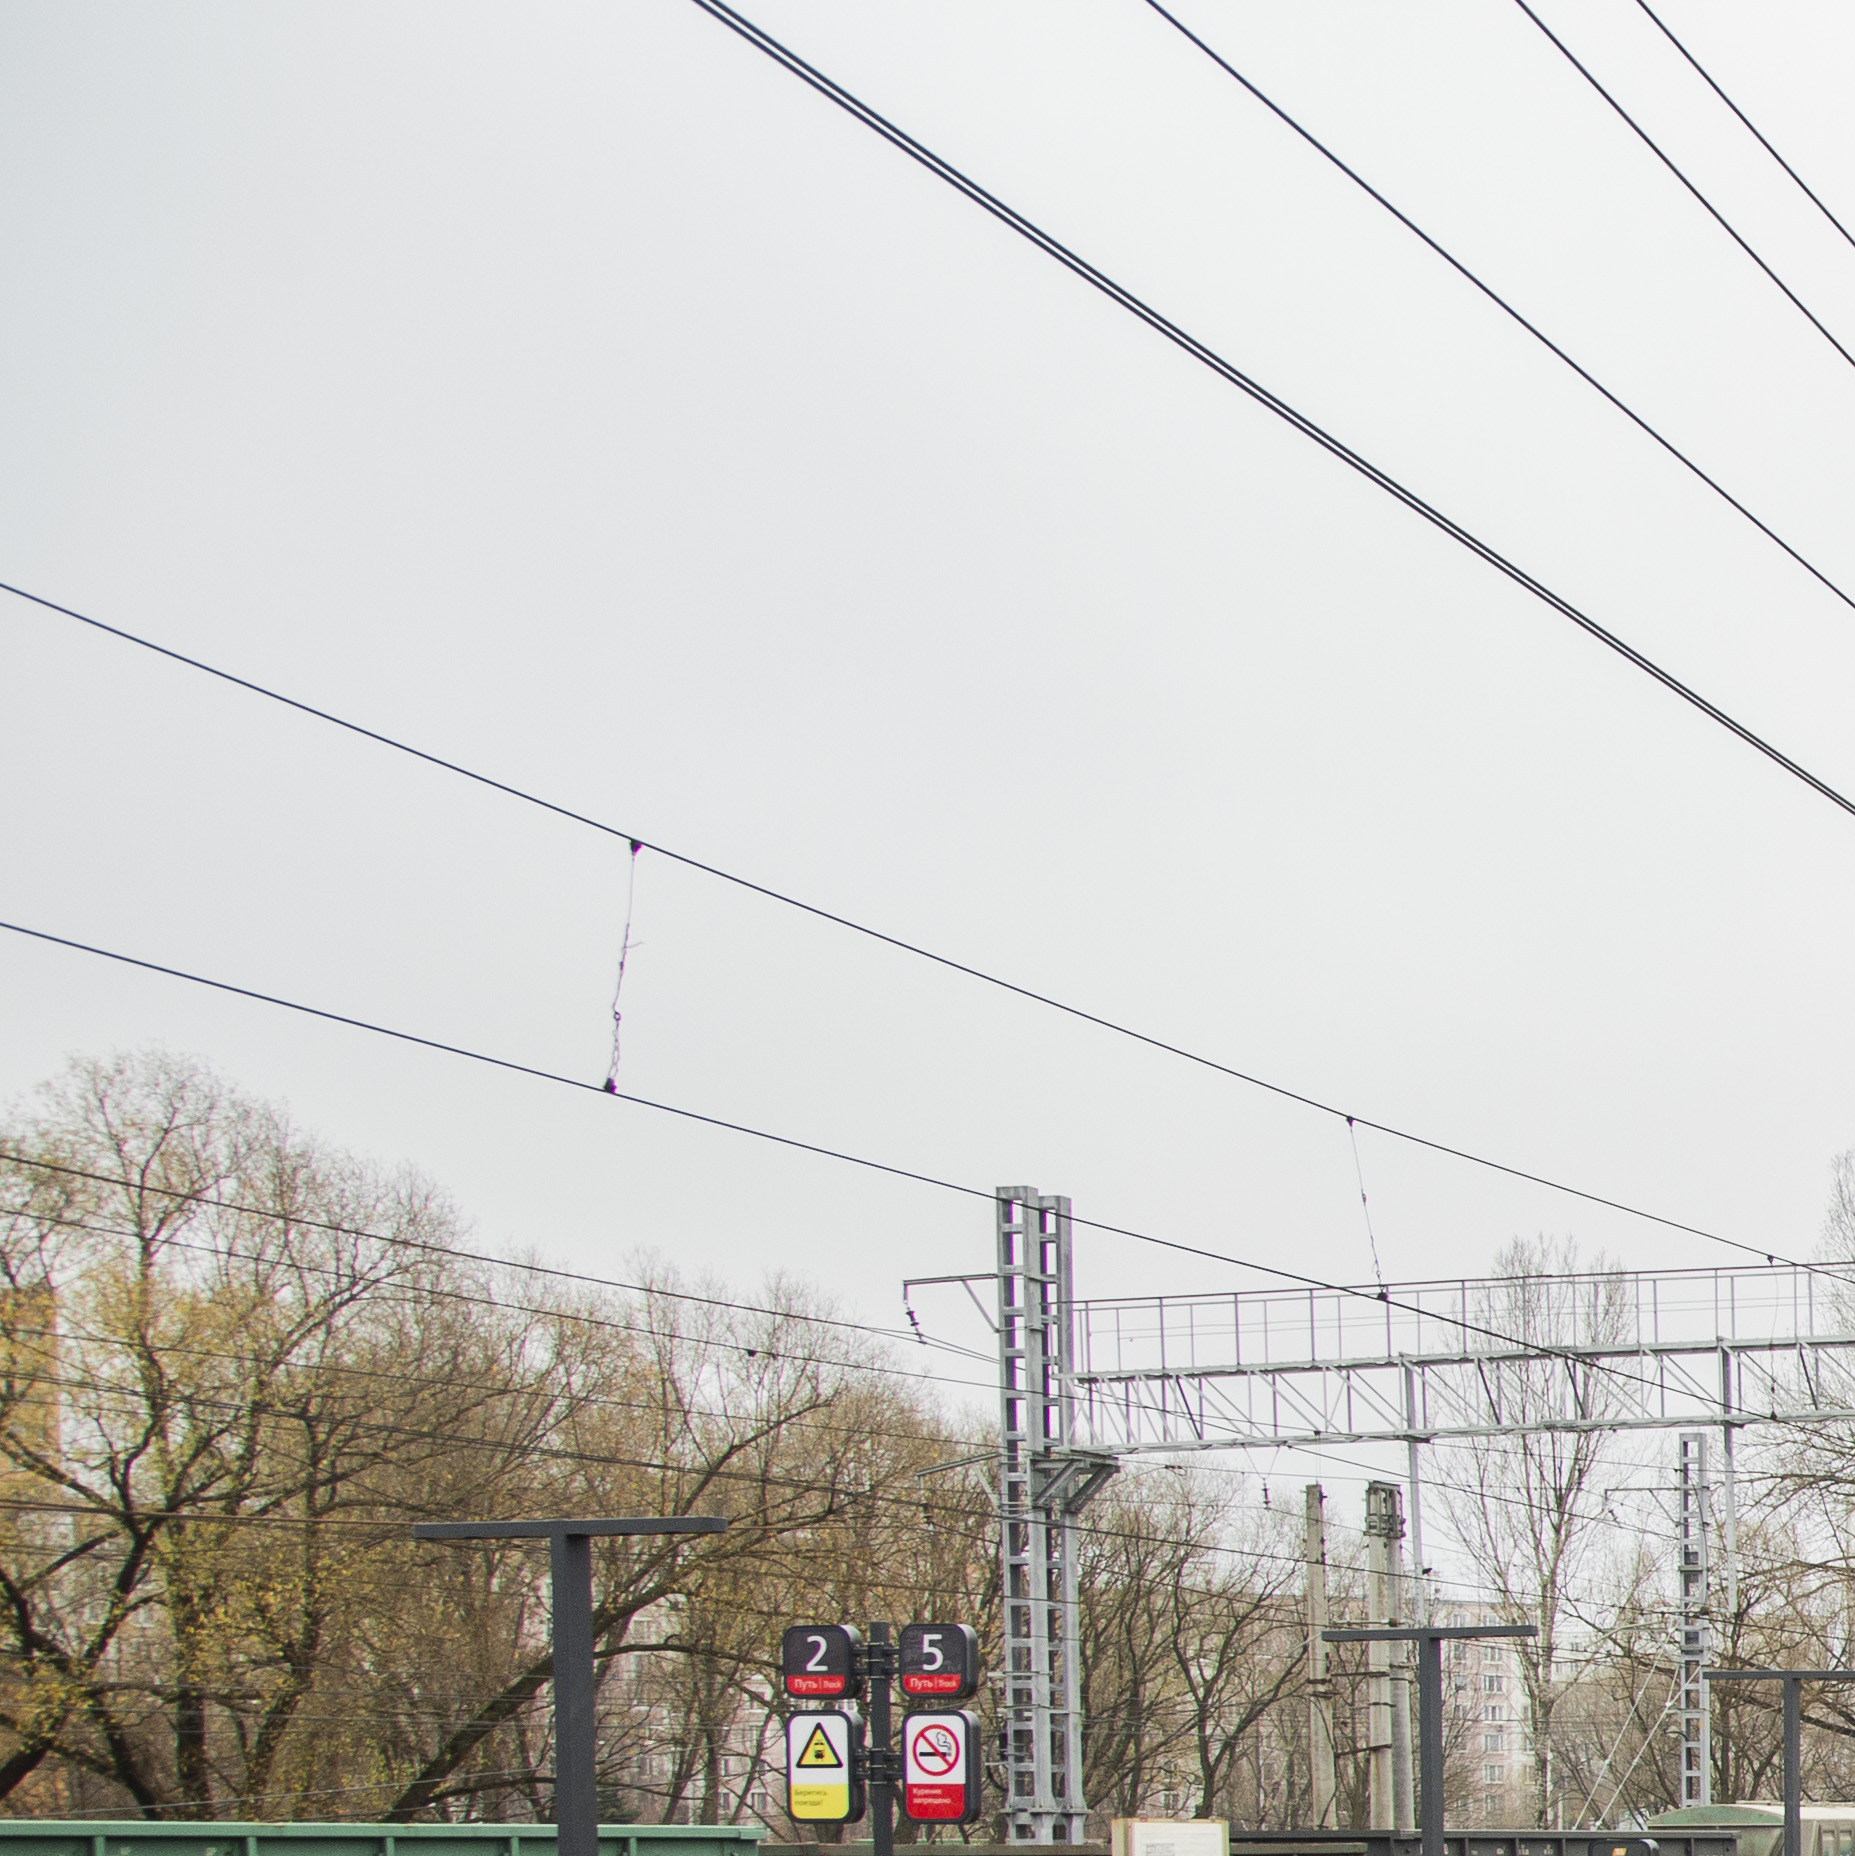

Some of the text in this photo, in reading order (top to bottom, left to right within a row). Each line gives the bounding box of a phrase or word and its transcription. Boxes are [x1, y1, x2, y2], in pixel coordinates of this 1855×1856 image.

[805, 1635, 829, 1672] 2
[921, 1633, 944, 1671] 5
[794, 1678, 818, 1692] Путь
[910, 1677, 934, 1691] Путь
